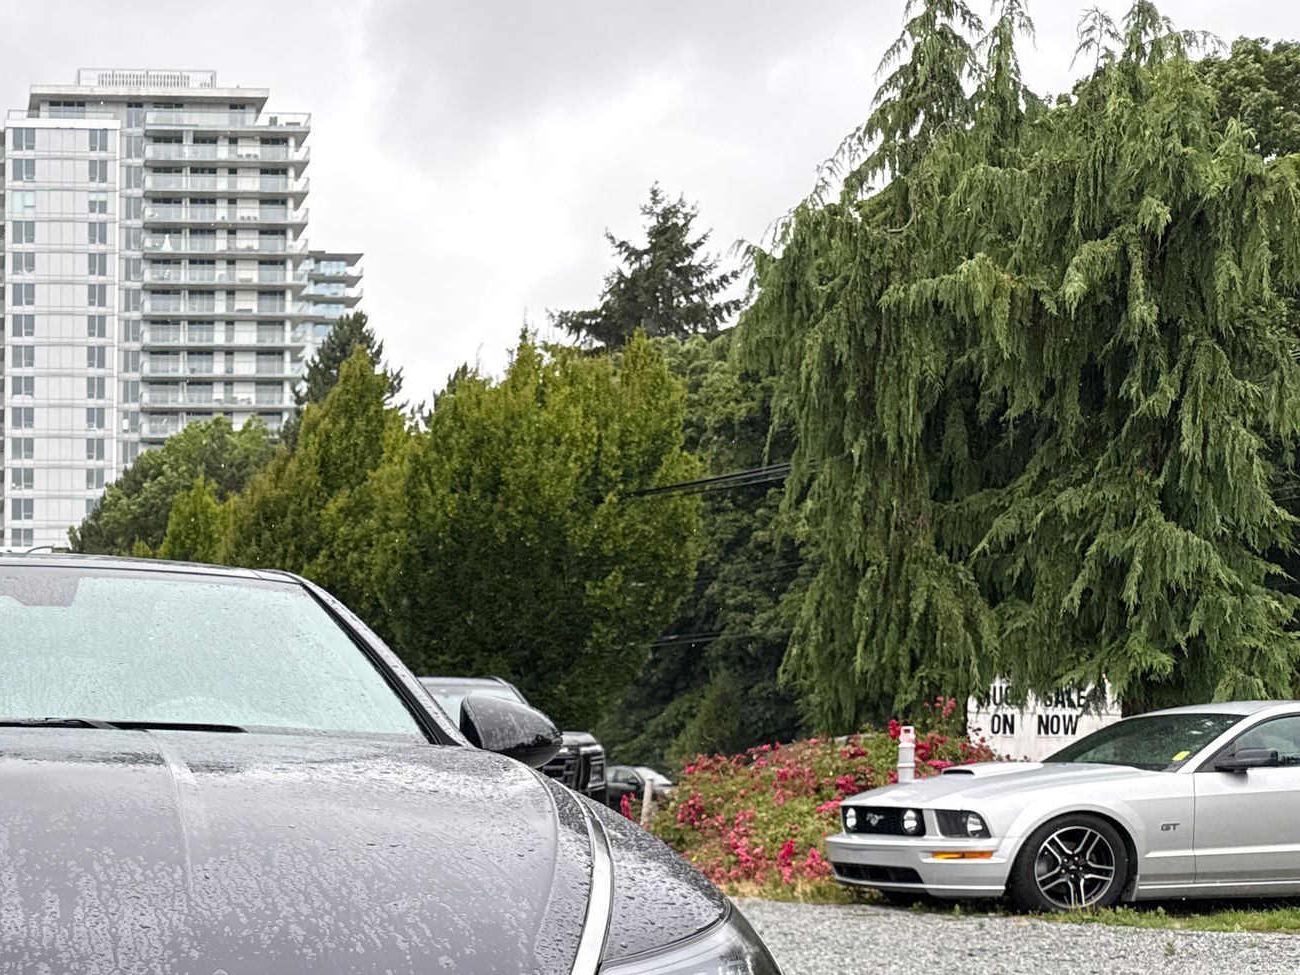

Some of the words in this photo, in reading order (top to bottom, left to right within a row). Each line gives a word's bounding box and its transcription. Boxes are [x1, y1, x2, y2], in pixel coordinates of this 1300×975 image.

[990, 714, 1015, 735] ON
[1037, 714, 1081, 735] NOW
[1161, 822, 1180, 831] GT
